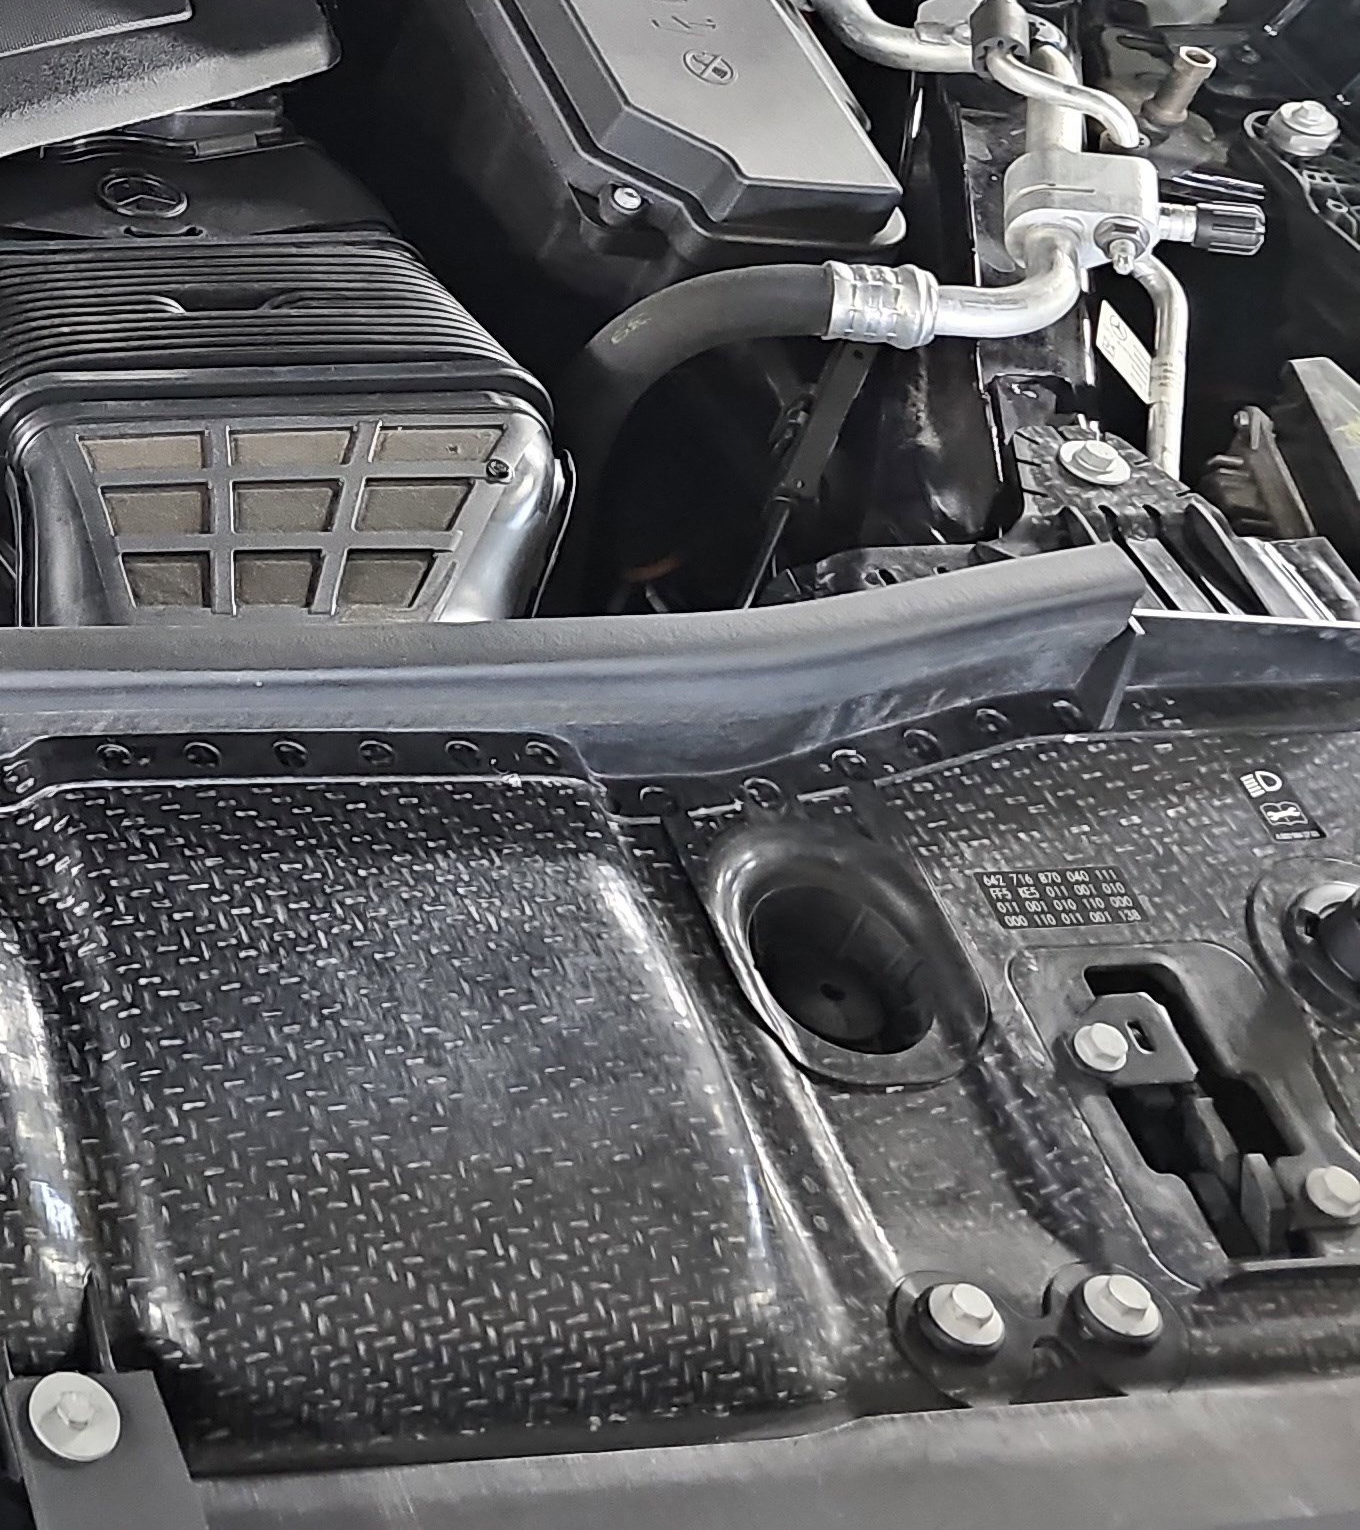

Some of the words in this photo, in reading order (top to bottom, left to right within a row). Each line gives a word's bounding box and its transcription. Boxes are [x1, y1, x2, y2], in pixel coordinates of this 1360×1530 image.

[983, 874, 1007, 886] 642
[1009, 873, 1034, 886] 716
[1038, 872, 1061, 884] 870
[1066, 870, 1089, 882] 040
[1095, 869, 1118, 881] 111
[1046, 885, 1069, 898] 011
[1074, 883, 1097, 896] 001
[1102, 882, 1125, 894] 010
[996, 901, 1020, 913] 011
[1025, 900, 1049, 912] 001
[1053, 899, 1077, 911] 010
[1082, 897, 1105, 910] 110
[1110, 895, 1133, 908] 000
[1004, 914, 1029, 927] 000
[1034, 913, 1057, 926] 110
[1061, 912, 1084, 924] 011
[1089, 910, 1112, 923] 001
[1118, 908, 1142, 921] 138
